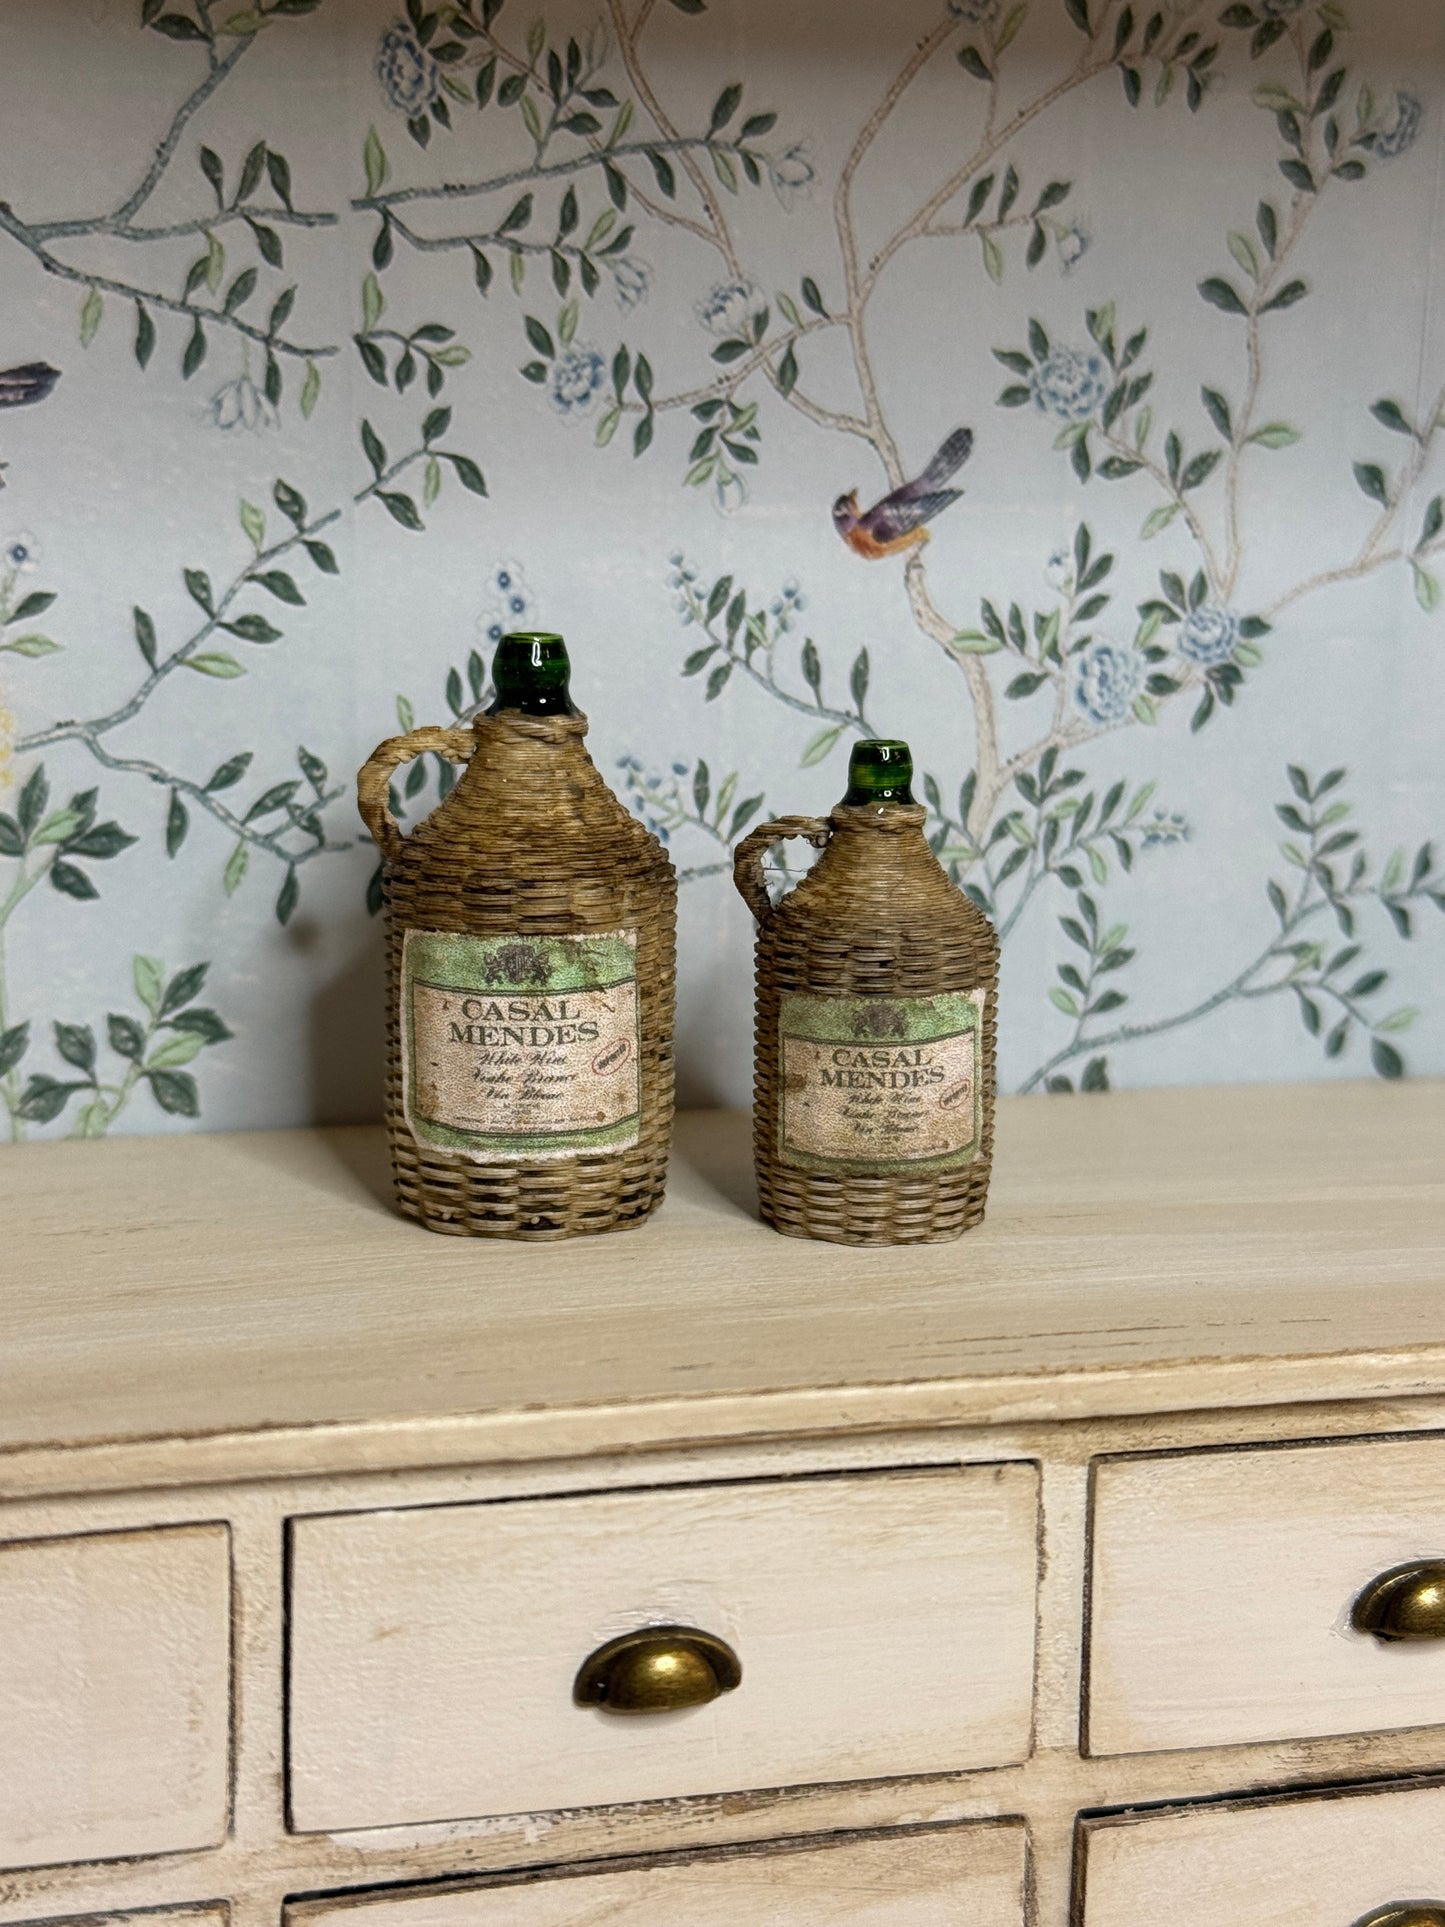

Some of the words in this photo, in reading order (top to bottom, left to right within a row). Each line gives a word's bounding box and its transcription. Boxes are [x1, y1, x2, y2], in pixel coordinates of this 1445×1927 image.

[461, 998, 581, 1022] CASAL
[449, 1021, 600, 1047] MENDES
[831, 1048, 932, 1068] CASAL
[818, 1065, 946, 1089] MENDES
